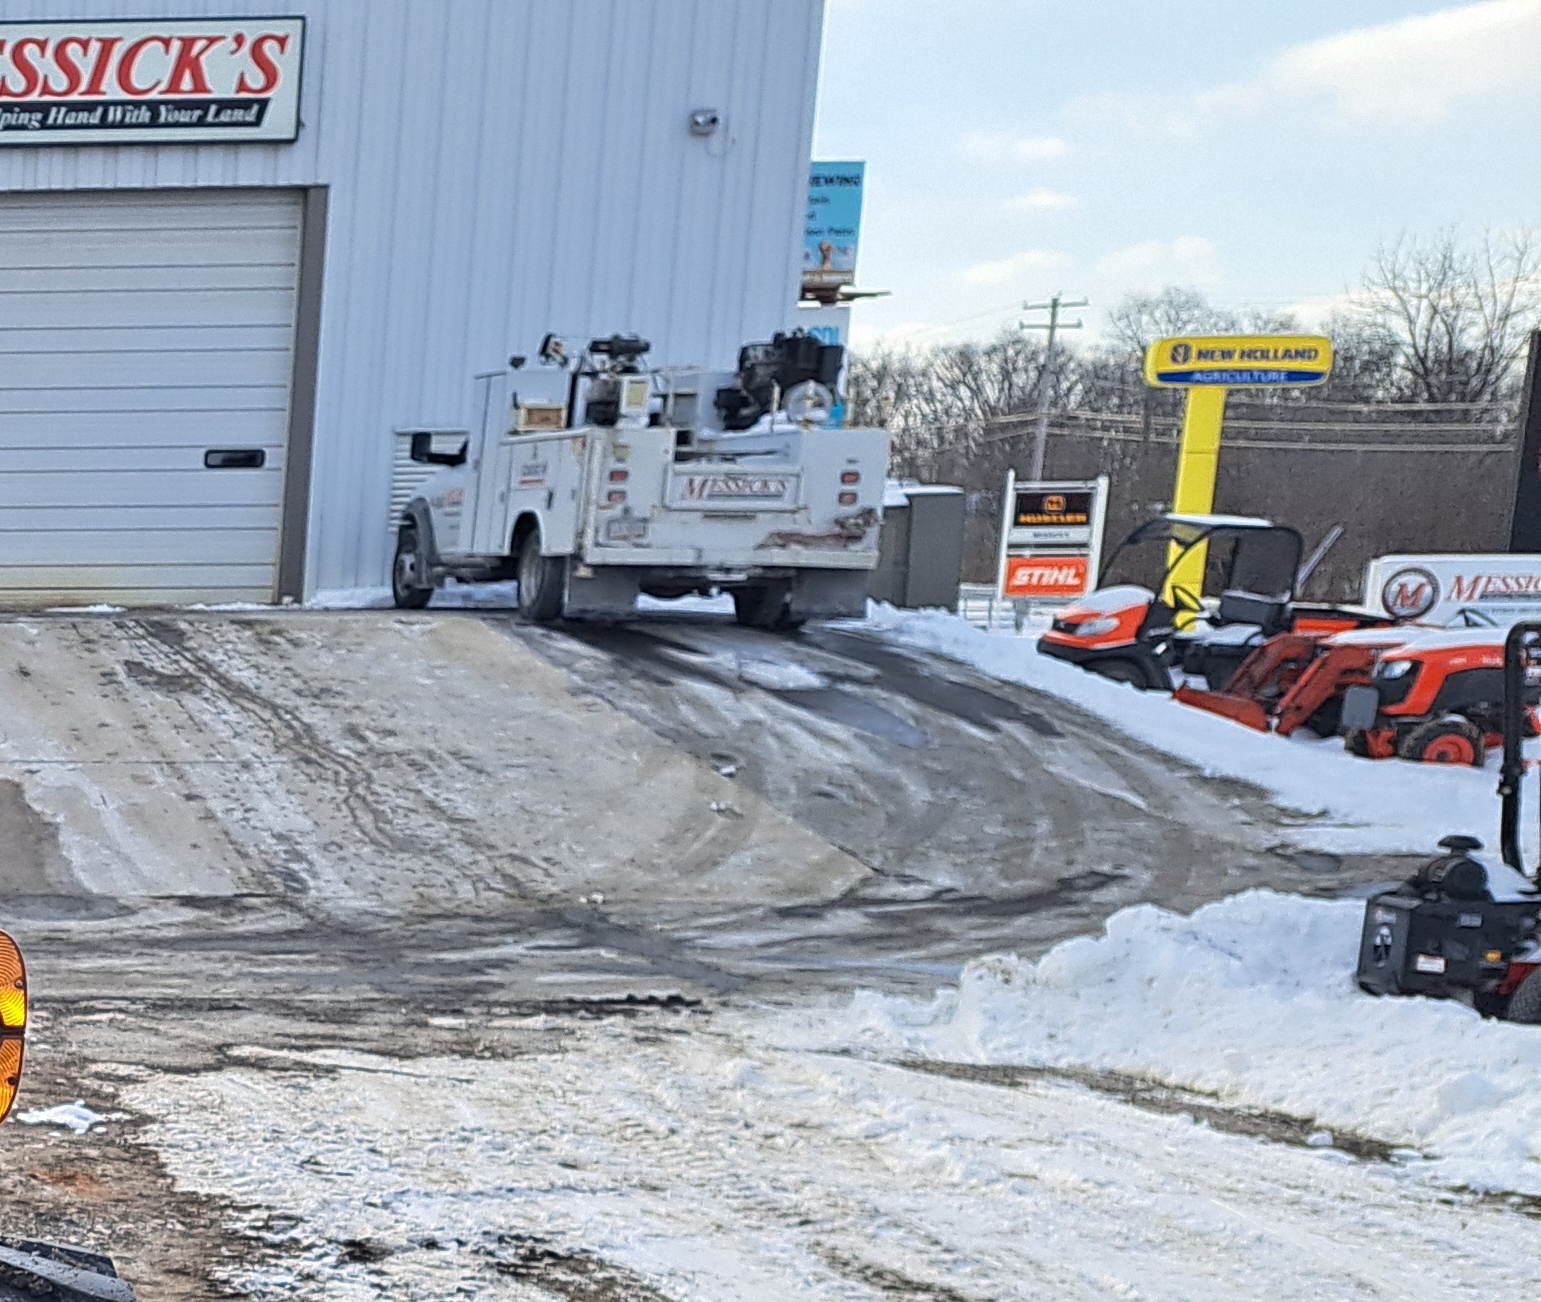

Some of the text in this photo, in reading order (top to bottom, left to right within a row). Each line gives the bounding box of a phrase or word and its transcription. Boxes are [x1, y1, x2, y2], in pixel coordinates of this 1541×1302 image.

[45, 105, 104, 125] Hand
[106, 104, 152, 124] With
[158, 103, 204, 124] Your
[205, 102, 261, 123] Land
[1197, 347, 1320, 361] NEW HOLLAND
[1192, 371, 1289, 382] AGRICULTURE
[1012, 565, 1082, 586] STIHL
